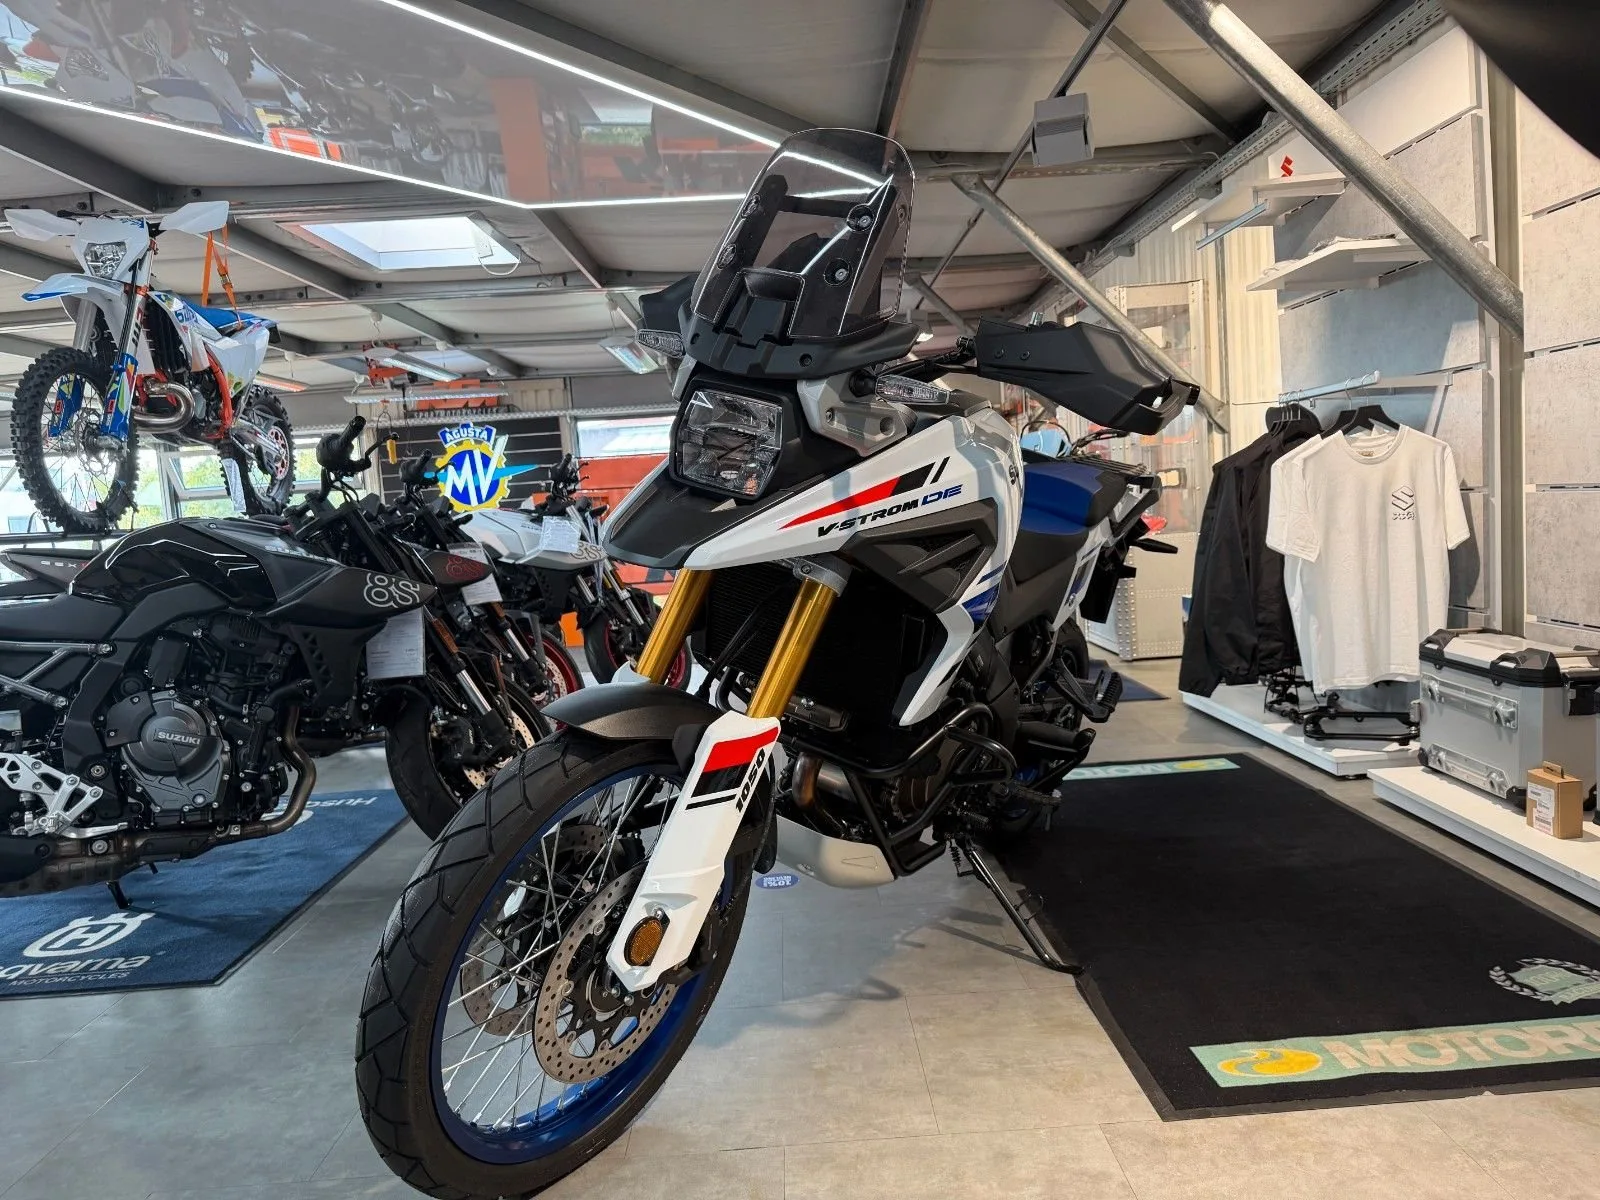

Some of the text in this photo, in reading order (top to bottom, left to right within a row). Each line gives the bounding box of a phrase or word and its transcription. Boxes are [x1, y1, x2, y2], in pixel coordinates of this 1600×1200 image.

[445, 427, 488, 442] AGUSTA
[444, 434, 509, 507] MV
[817, 484, 963, 538] V-STROM DE
[157, 731, 201, 745] SUZUKI
[735, 748, 766, 813] 1050
[9, 971, 131, 986] MOTORCYCLES
